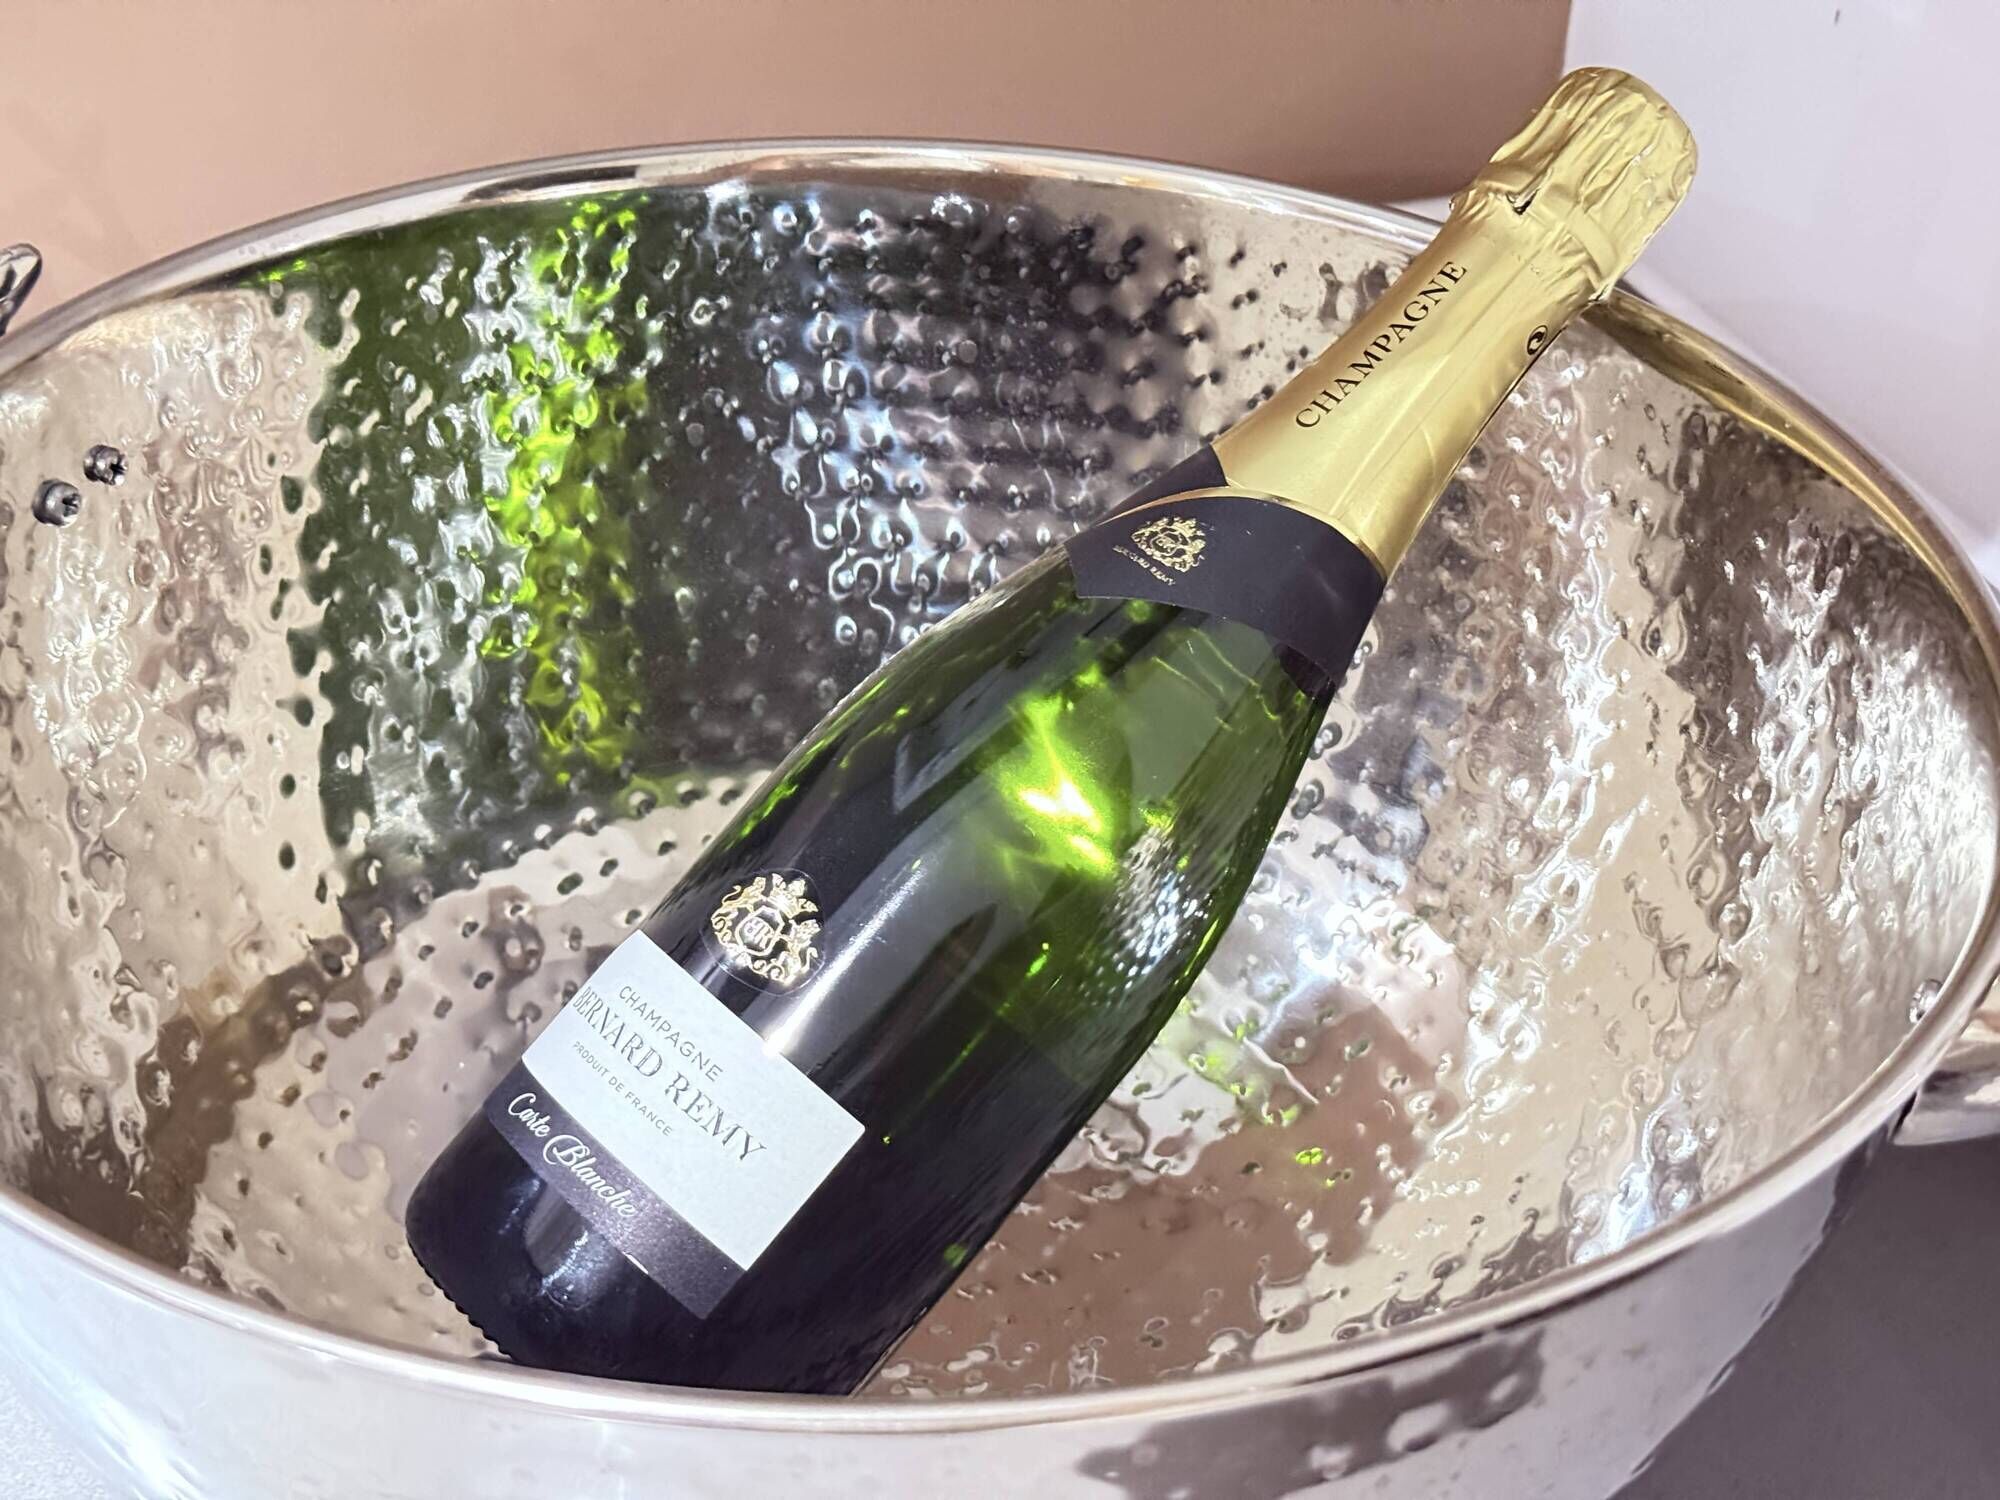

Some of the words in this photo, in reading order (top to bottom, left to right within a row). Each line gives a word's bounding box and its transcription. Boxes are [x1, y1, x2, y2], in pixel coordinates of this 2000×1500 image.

[1295, 261, 1468, 428] CHAMPAGNE
[572, 986, 664, 1078] BERNARD
[664, 1071, 767, 1161] REMY
[573, 1041, 610, 1077] PRODUIT
[607, 1075, 625, 1093] DE
[624, 1091, 673, 1137] FRANCE
[618, 985, 724, 1082] CHAMPAGNE
[507, 1092, 551, 1138] Carte
[542, 1134, 638, 1218] Blanche
